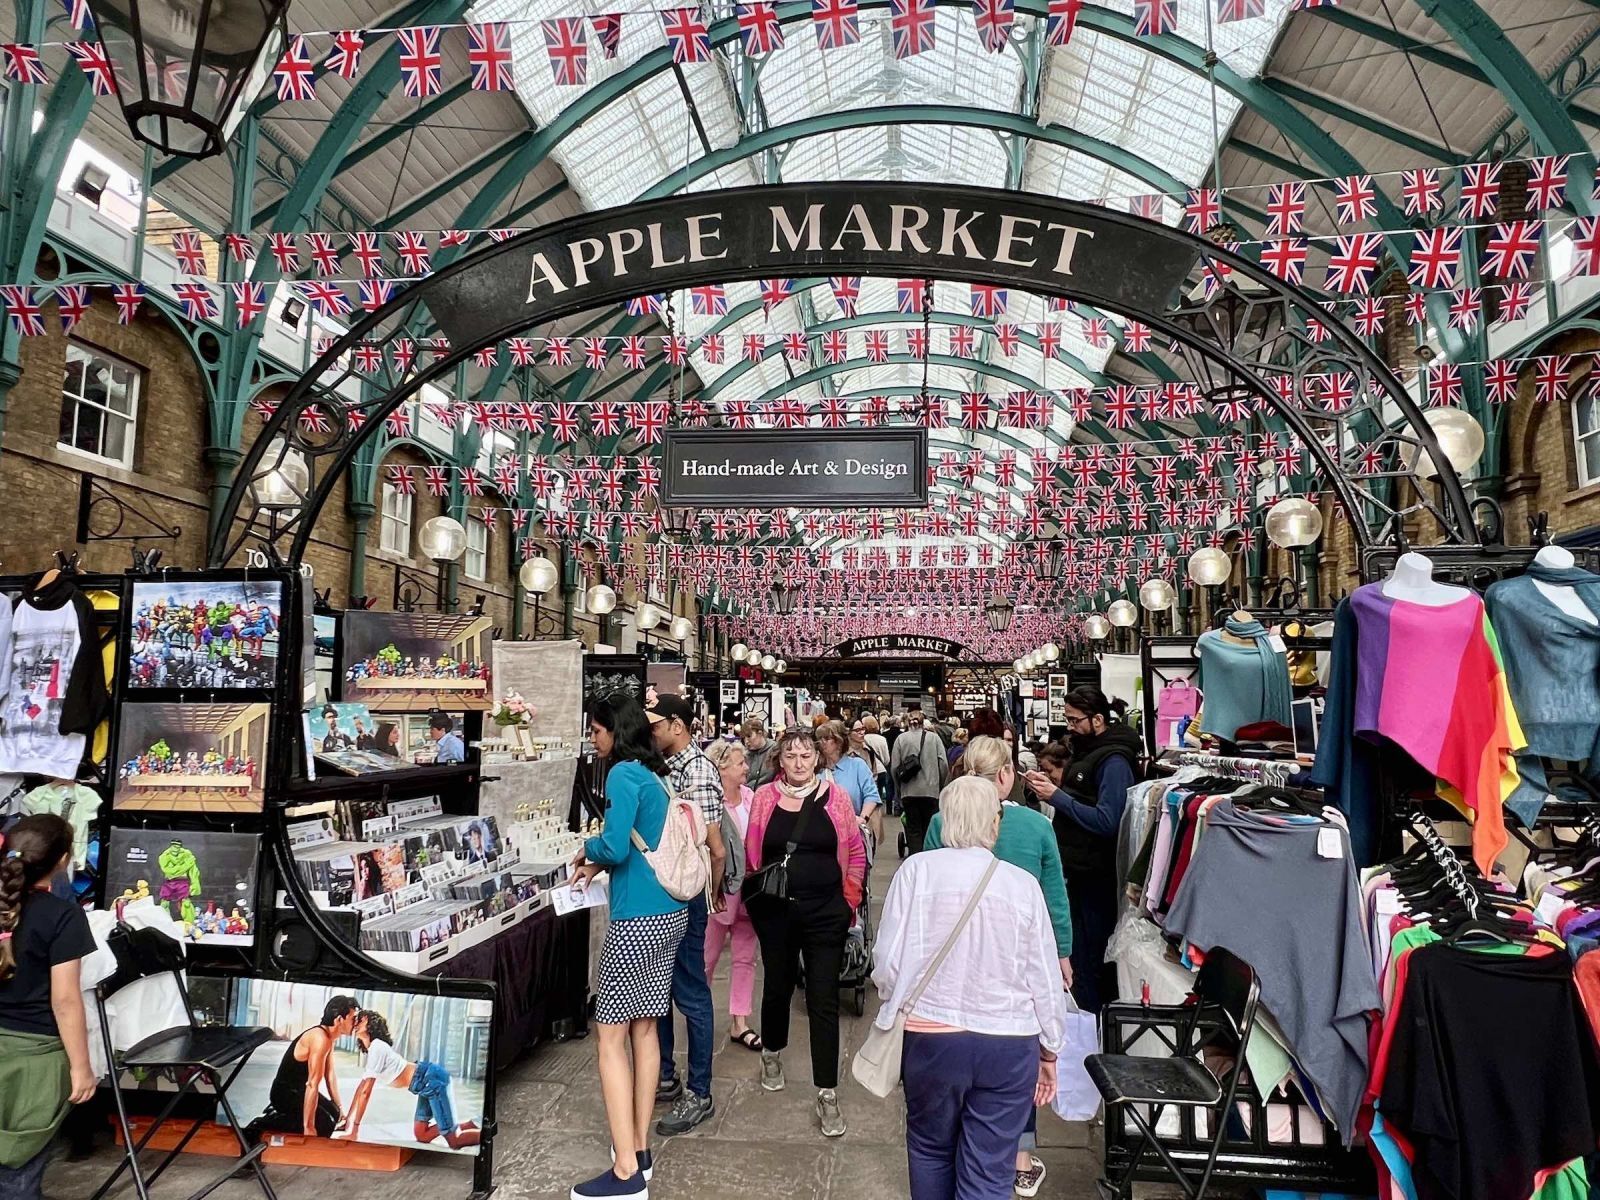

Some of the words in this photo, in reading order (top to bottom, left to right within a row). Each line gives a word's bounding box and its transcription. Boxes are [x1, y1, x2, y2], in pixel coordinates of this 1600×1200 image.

[525, 212, 728, 304] APPLE
[768, 203, 1095, 276] MARKET
[681, 459, 785, 476] Hand-made
[788, 459, 819, 476] Art
[823, 460, 839, 476] &
[844, 458, 908, 480] Design
[852, 637, 889, 652] APPLE
[897, 637, 952, 653] MARKET
